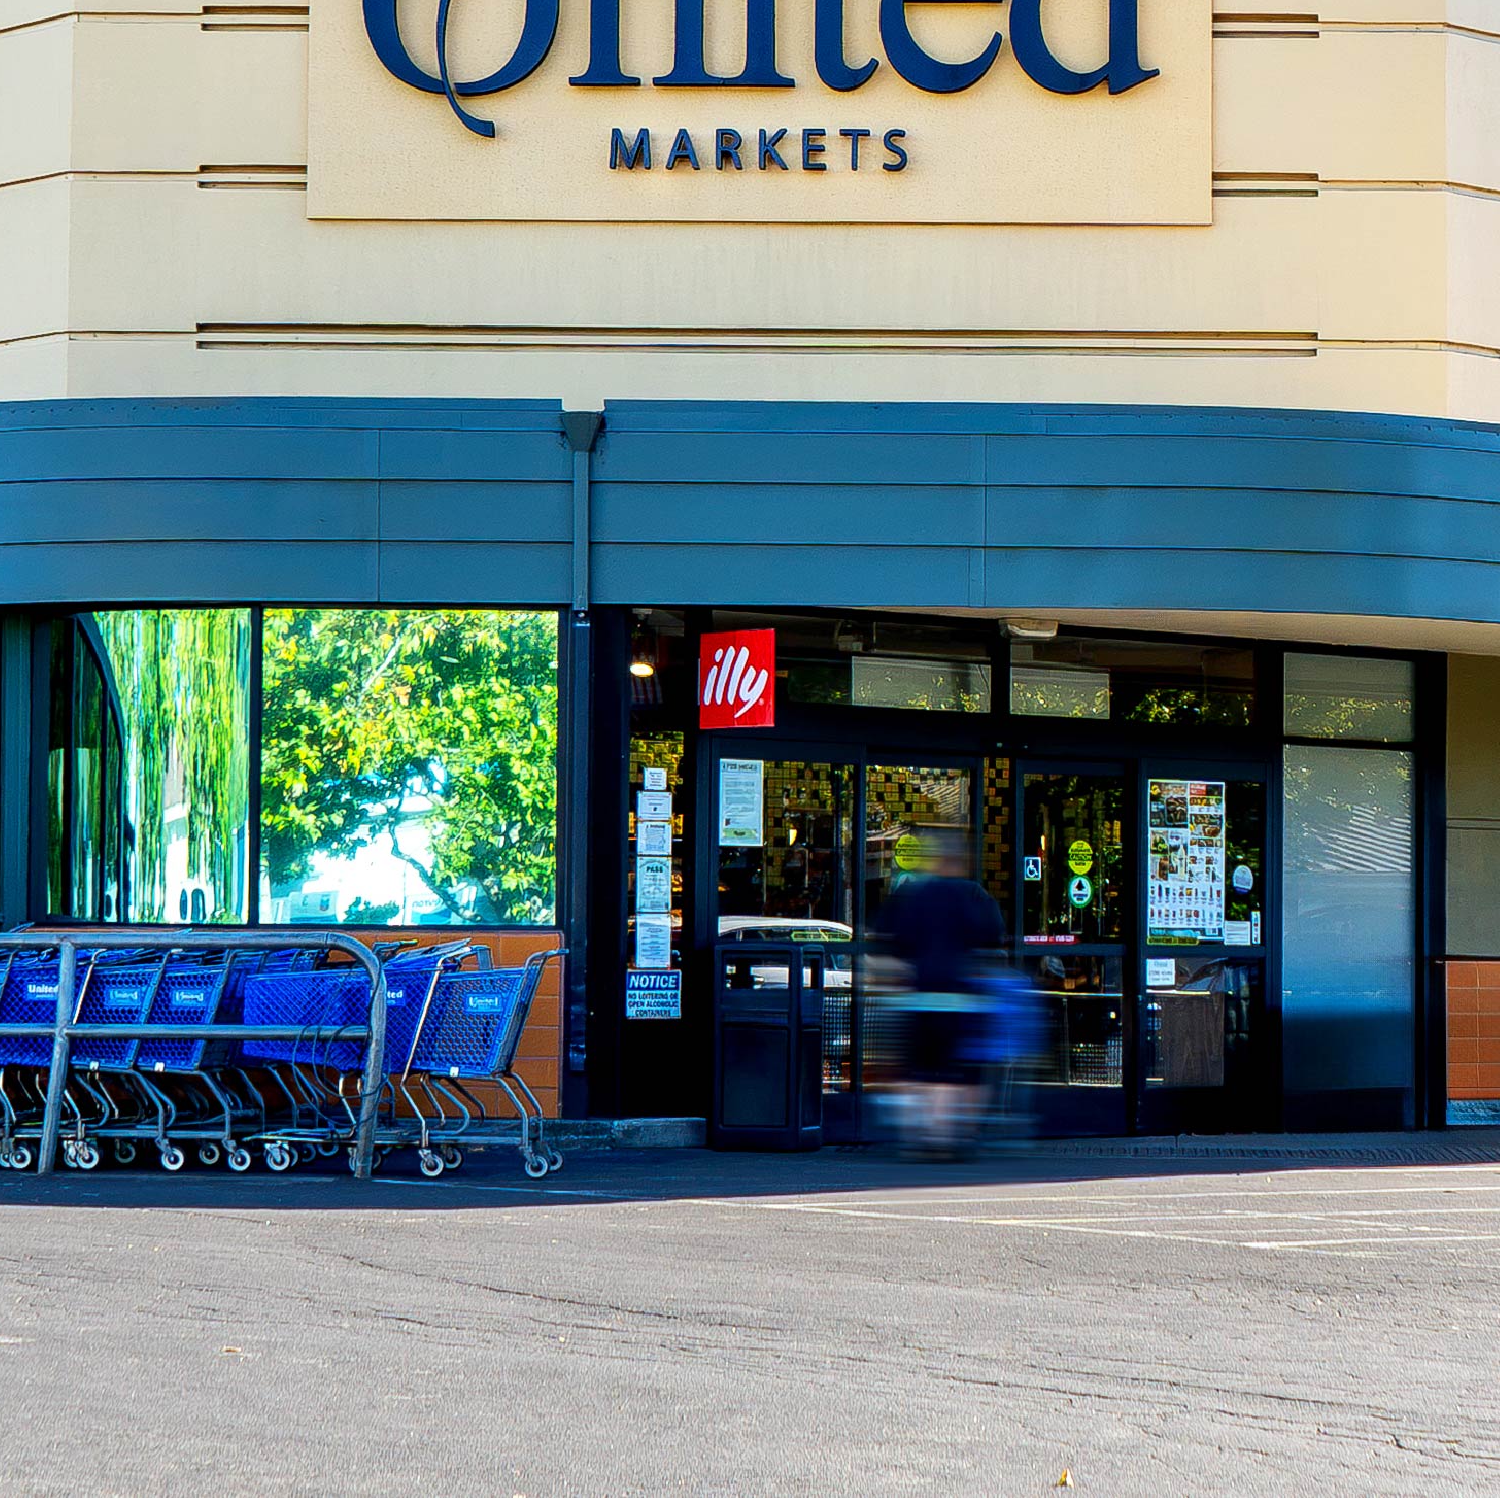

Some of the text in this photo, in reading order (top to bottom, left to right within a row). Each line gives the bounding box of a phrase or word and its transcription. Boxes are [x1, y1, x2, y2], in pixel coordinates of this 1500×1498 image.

[609, 127, 910, 172] MARKETS
[703, 645, 769, 719] illy
[629, 974, 678, 989] NOTICE
